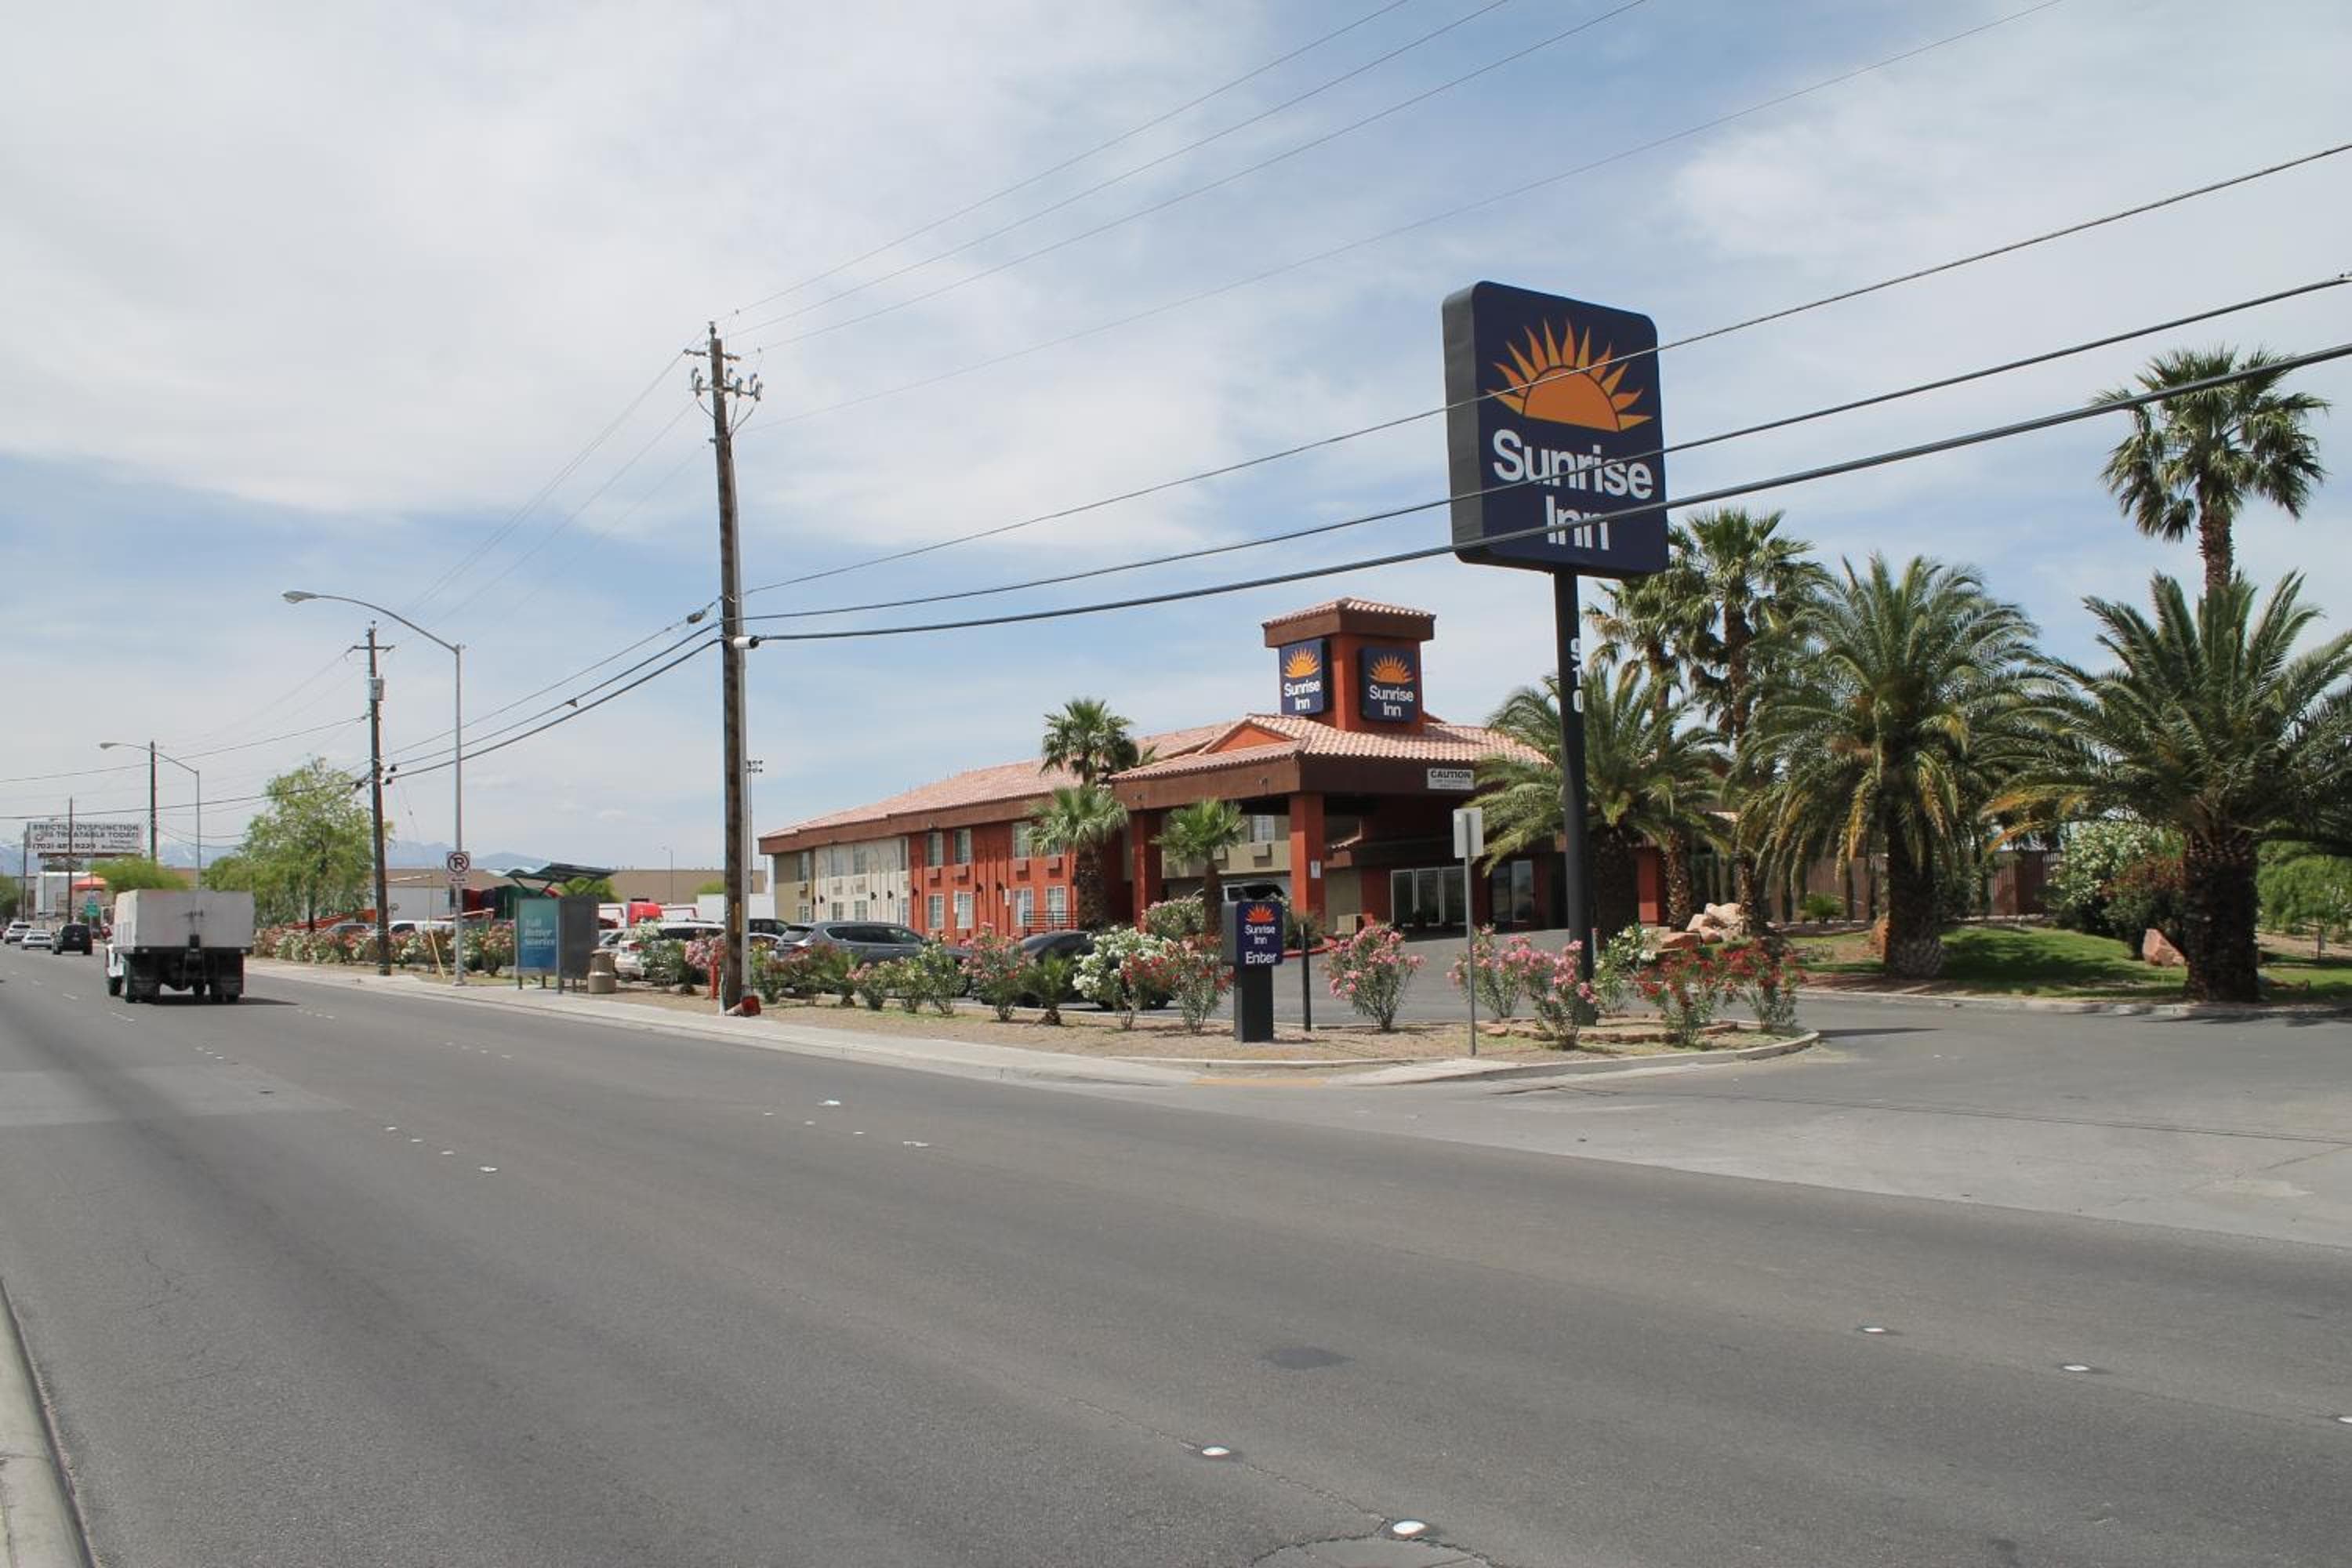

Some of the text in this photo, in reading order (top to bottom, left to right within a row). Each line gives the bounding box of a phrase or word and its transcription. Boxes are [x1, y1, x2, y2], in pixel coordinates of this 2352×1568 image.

[1492, 428, 1653, 499] Sunrise
[1544, 495, 1610, 550] Inn
[1283, 680, 1321, 697] Sunrise
[1369, 684, 1414, 702] Sunrise
[1295, 697, 1311, 711] Inn
[1383, 702, 1402, 717] Inn
[1430, 770, 1472, 779] CAUTION
[1244, 924, 1276, 935] Sunrise
[1254, 935, 1268, 945] Inn
[1245, 951, 1277, 964] Enter
